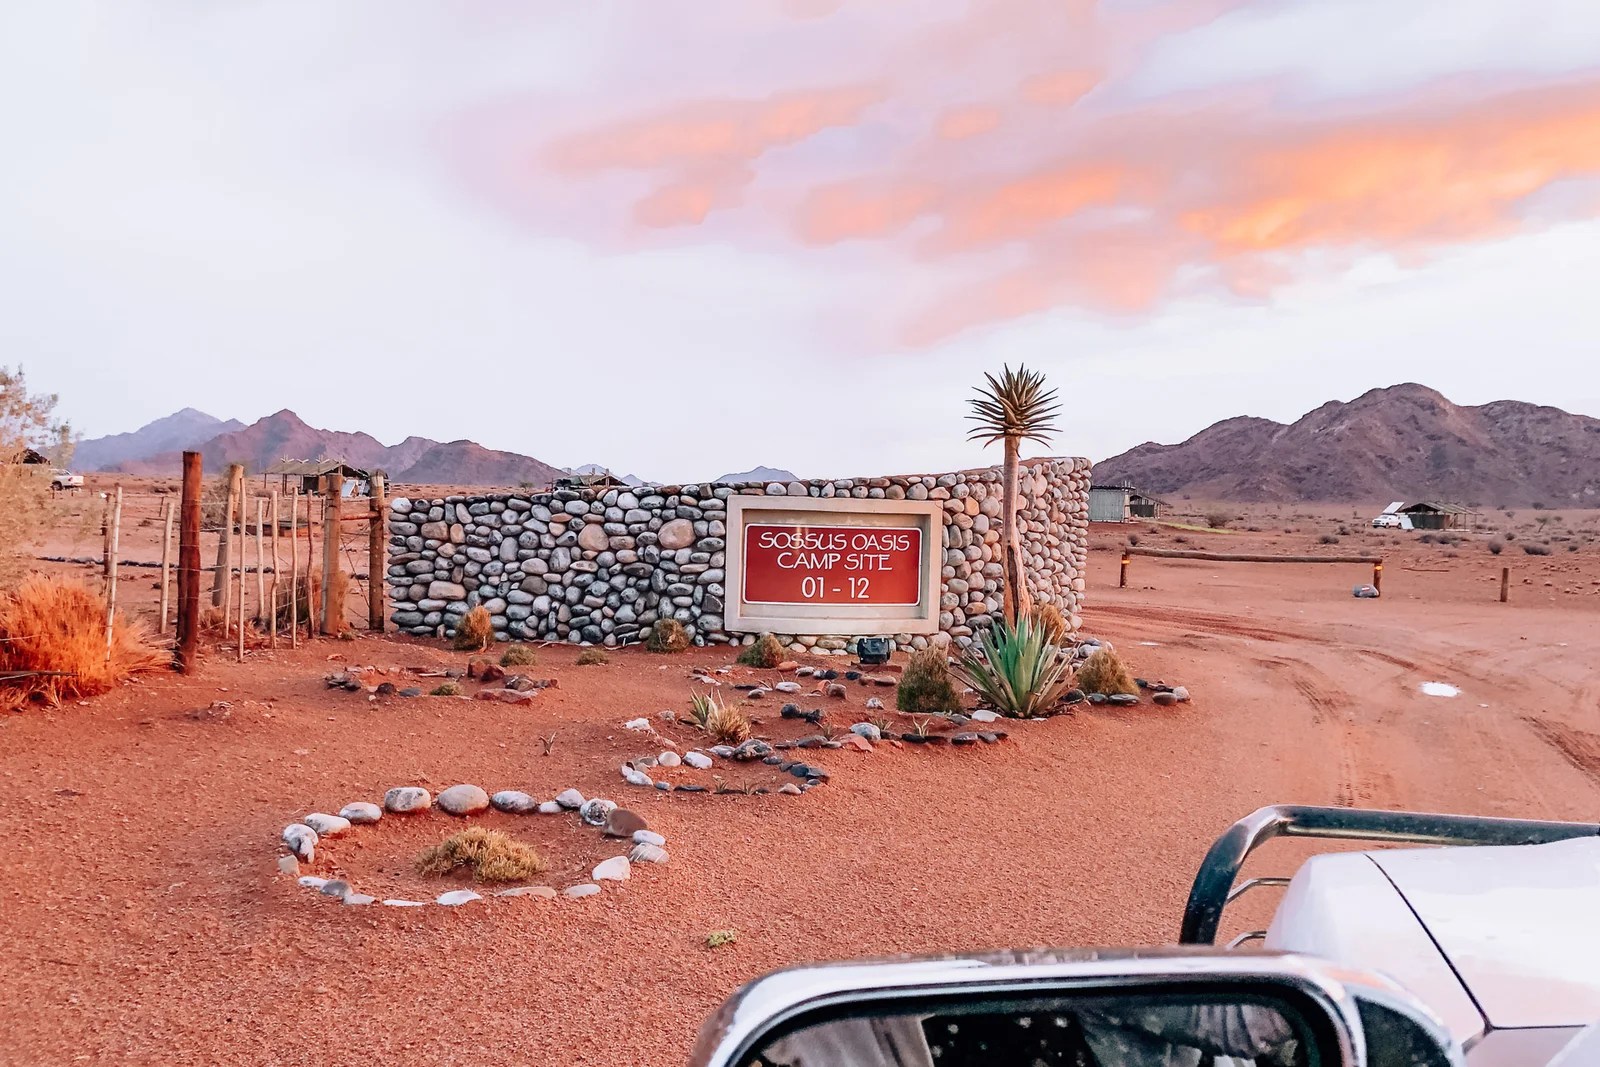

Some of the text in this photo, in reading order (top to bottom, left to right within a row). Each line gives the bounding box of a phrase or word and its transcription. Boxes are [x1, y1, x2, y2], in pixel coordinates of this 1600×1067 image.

[758, 532, 910, 551] SOSSUS OASIS
[777, 552, 893, 571] CAMP SITE
[801, 576, 825, 598] 01
[848, 577, 869, 599] 12
